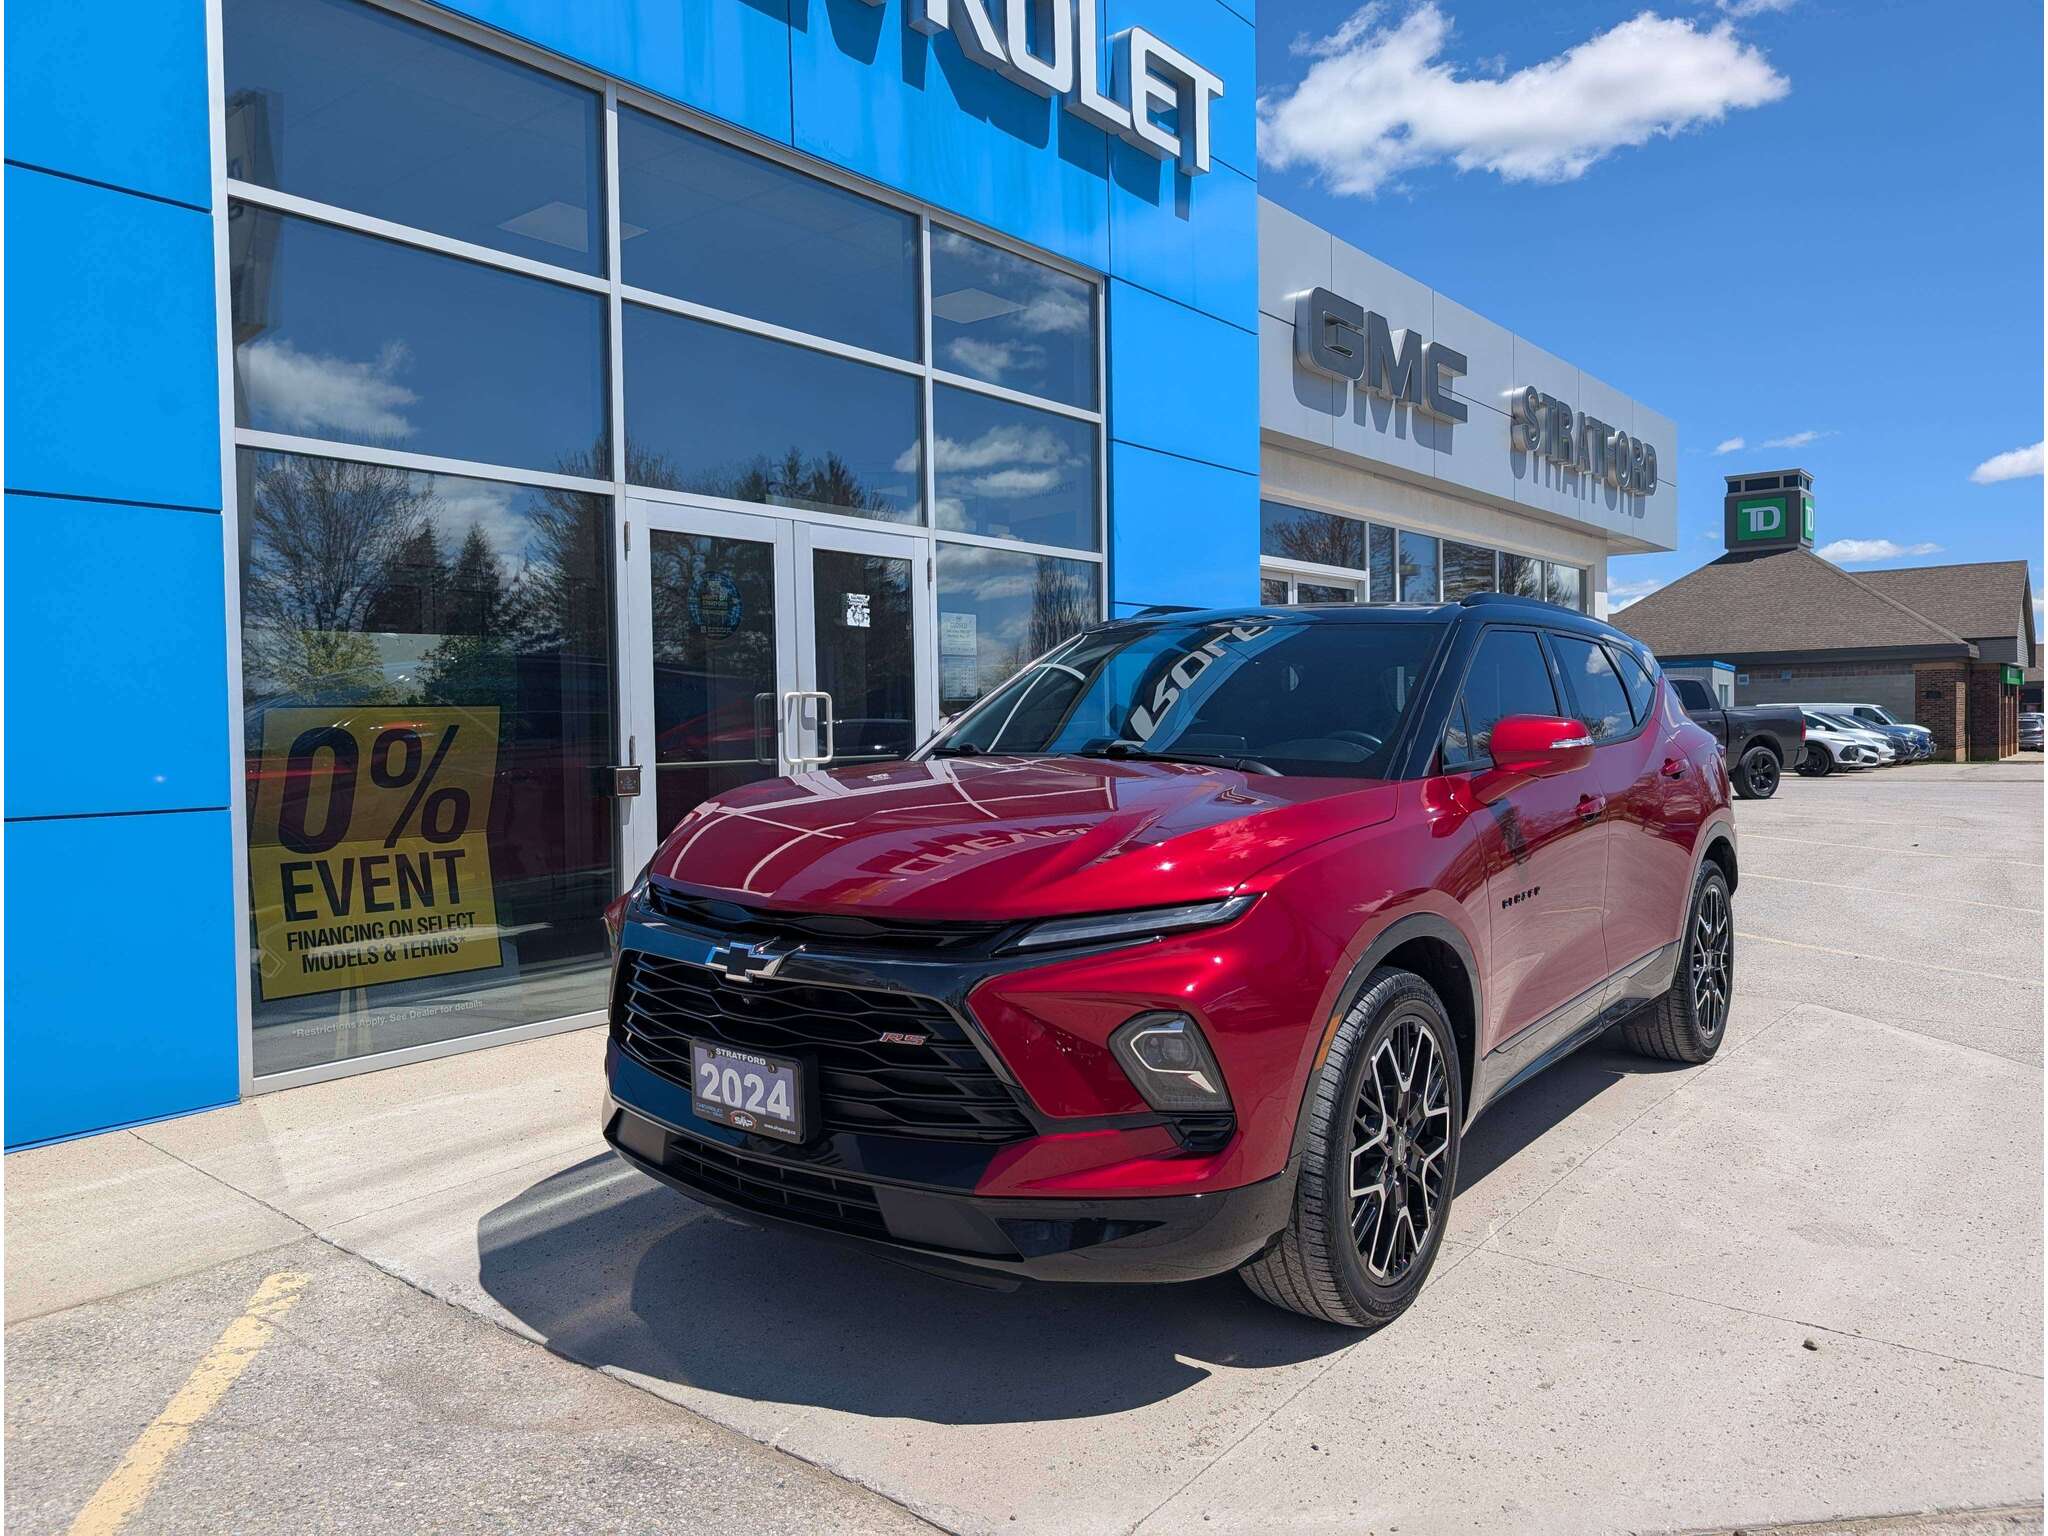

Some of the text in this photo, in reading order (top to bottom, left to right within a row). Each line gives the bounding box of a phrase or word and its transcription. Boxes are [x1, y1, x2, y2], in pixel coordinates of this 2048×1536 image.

[910, 0, 1224, 175] OLET
[1295, 287, 1468, 424] GMC
[1512, 385, 1657, 497] STRATFORD
[1742, 506, 1781, 532] TD
[278, 724, 471, 854] 0%
[279, 849, 466, 922] EVENT
[287, 912, 476, 951] FINANCING ON SELECT
[302, 946, 379, 974] MODELS
[383, 944, 397, 963] &
[389, 1012, 408, 1023] See
[409, 1007, 439, 1020] Dealer
[440, 1005, 454, 1015] for
[715, 1047, 766, 1066] STRATFORD
[880, 1032, 926, 1046] RS
[701, 1062, 790, 1120] 2024
